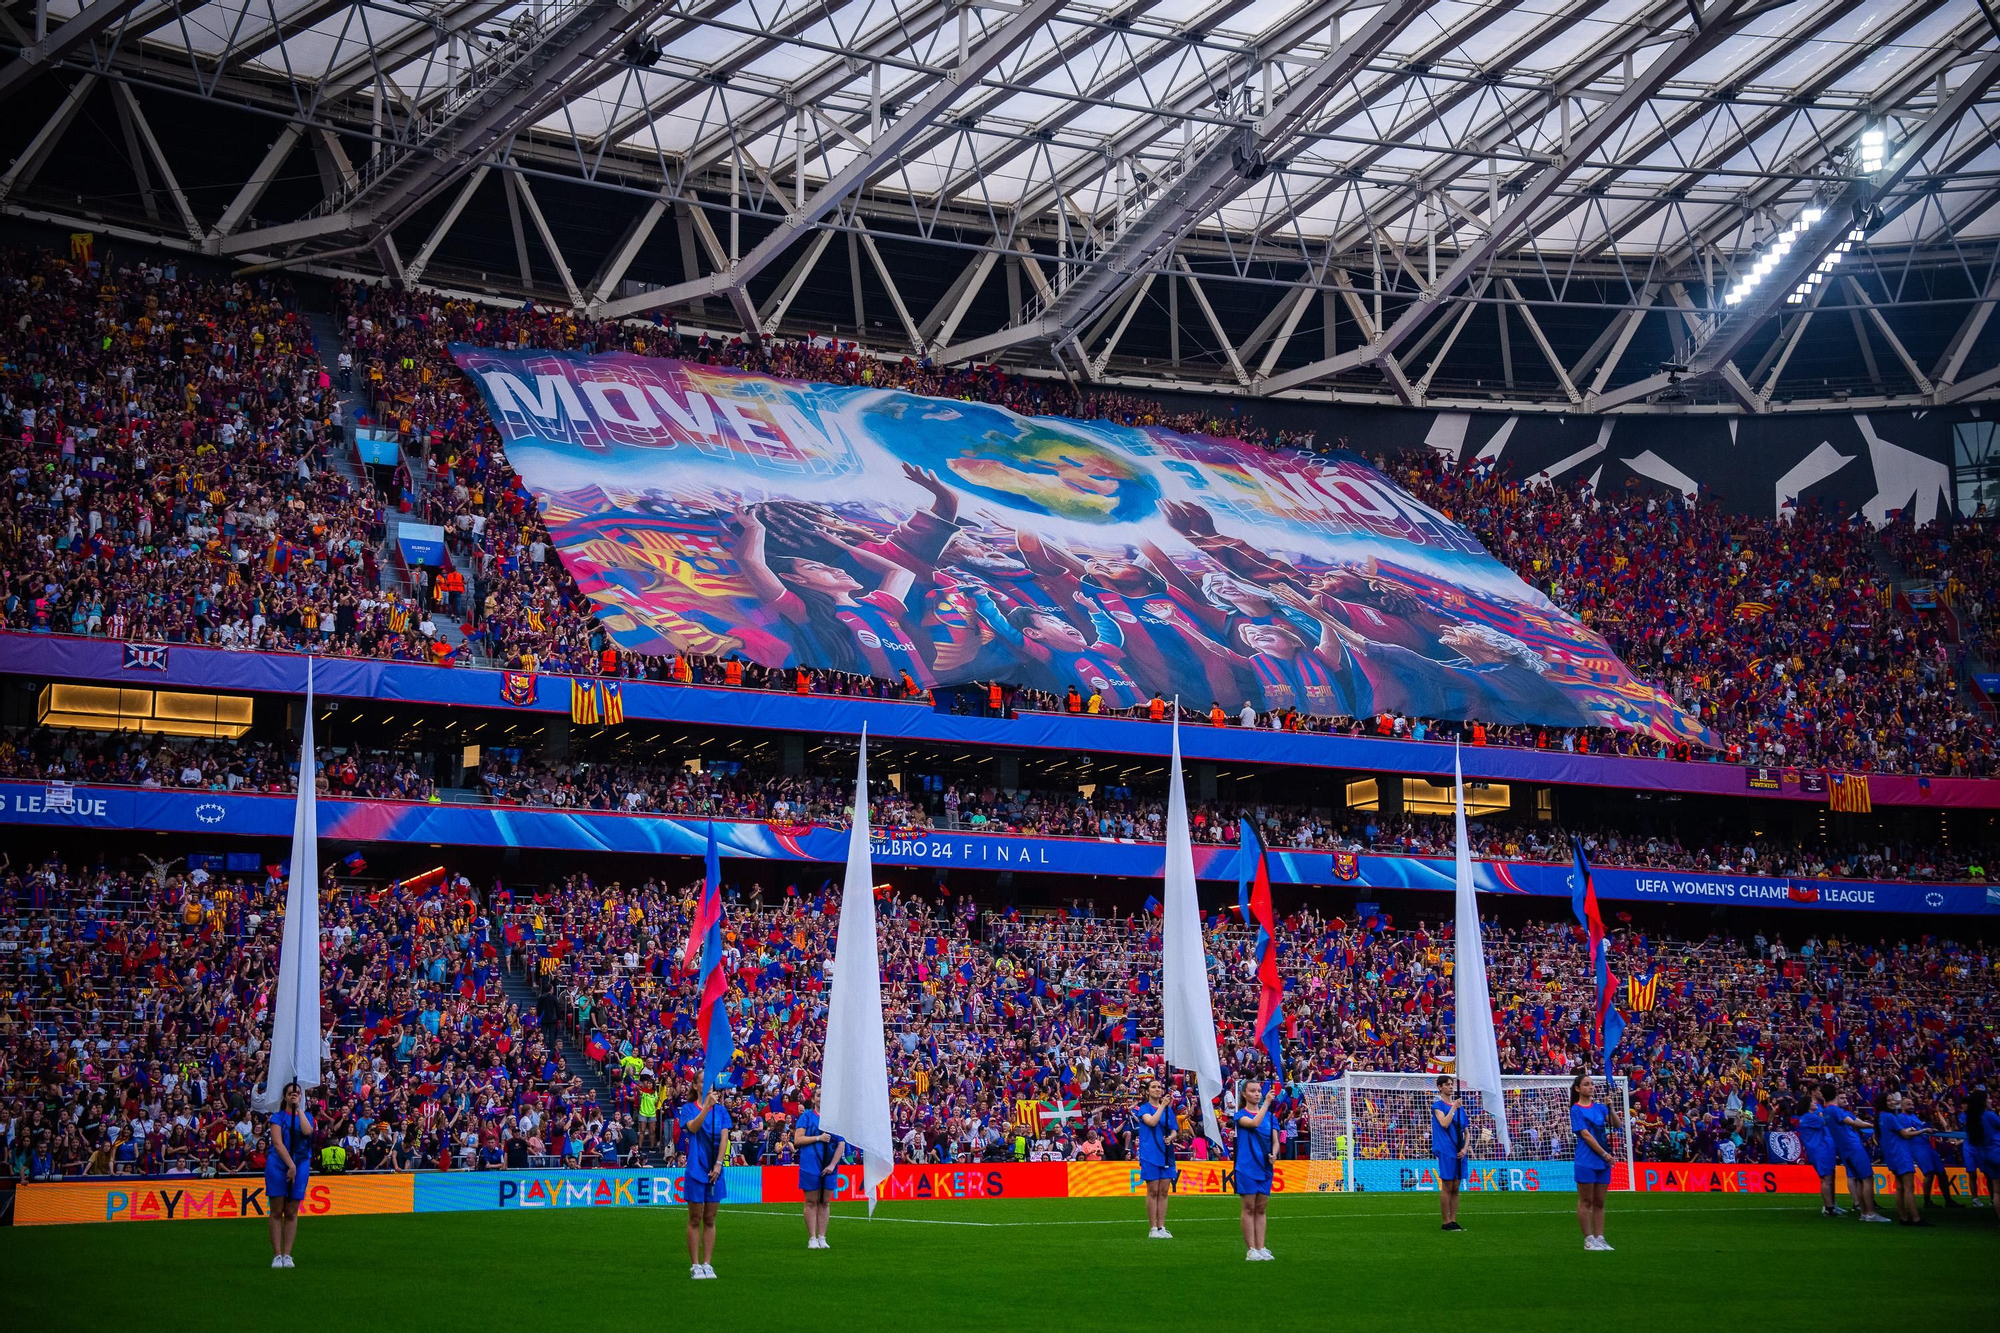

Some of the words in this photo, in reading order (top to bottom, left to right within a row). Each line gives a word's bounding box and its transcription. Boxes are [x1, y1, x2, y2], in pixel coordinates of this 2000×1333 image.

[480, 370, 855, 456] MOVEM
[931, 842, 953, 859] 24
[964, 844, 1050, 863] FINAL
[1635, 879, 1669, 893] UEFA
[1671, 880, 1735, 896] WOMEN'S
[1739, 884, 1821, 900] CHAMPS
[1825, 889, 1875, 903] LEAGUE
[833, 1171, 1004, 1199] PLYMAKERS
[1645, 1169, 1777, 1193] PLAYMAKERS
[106, 1185, 331, 1220] PLAYMAKS
